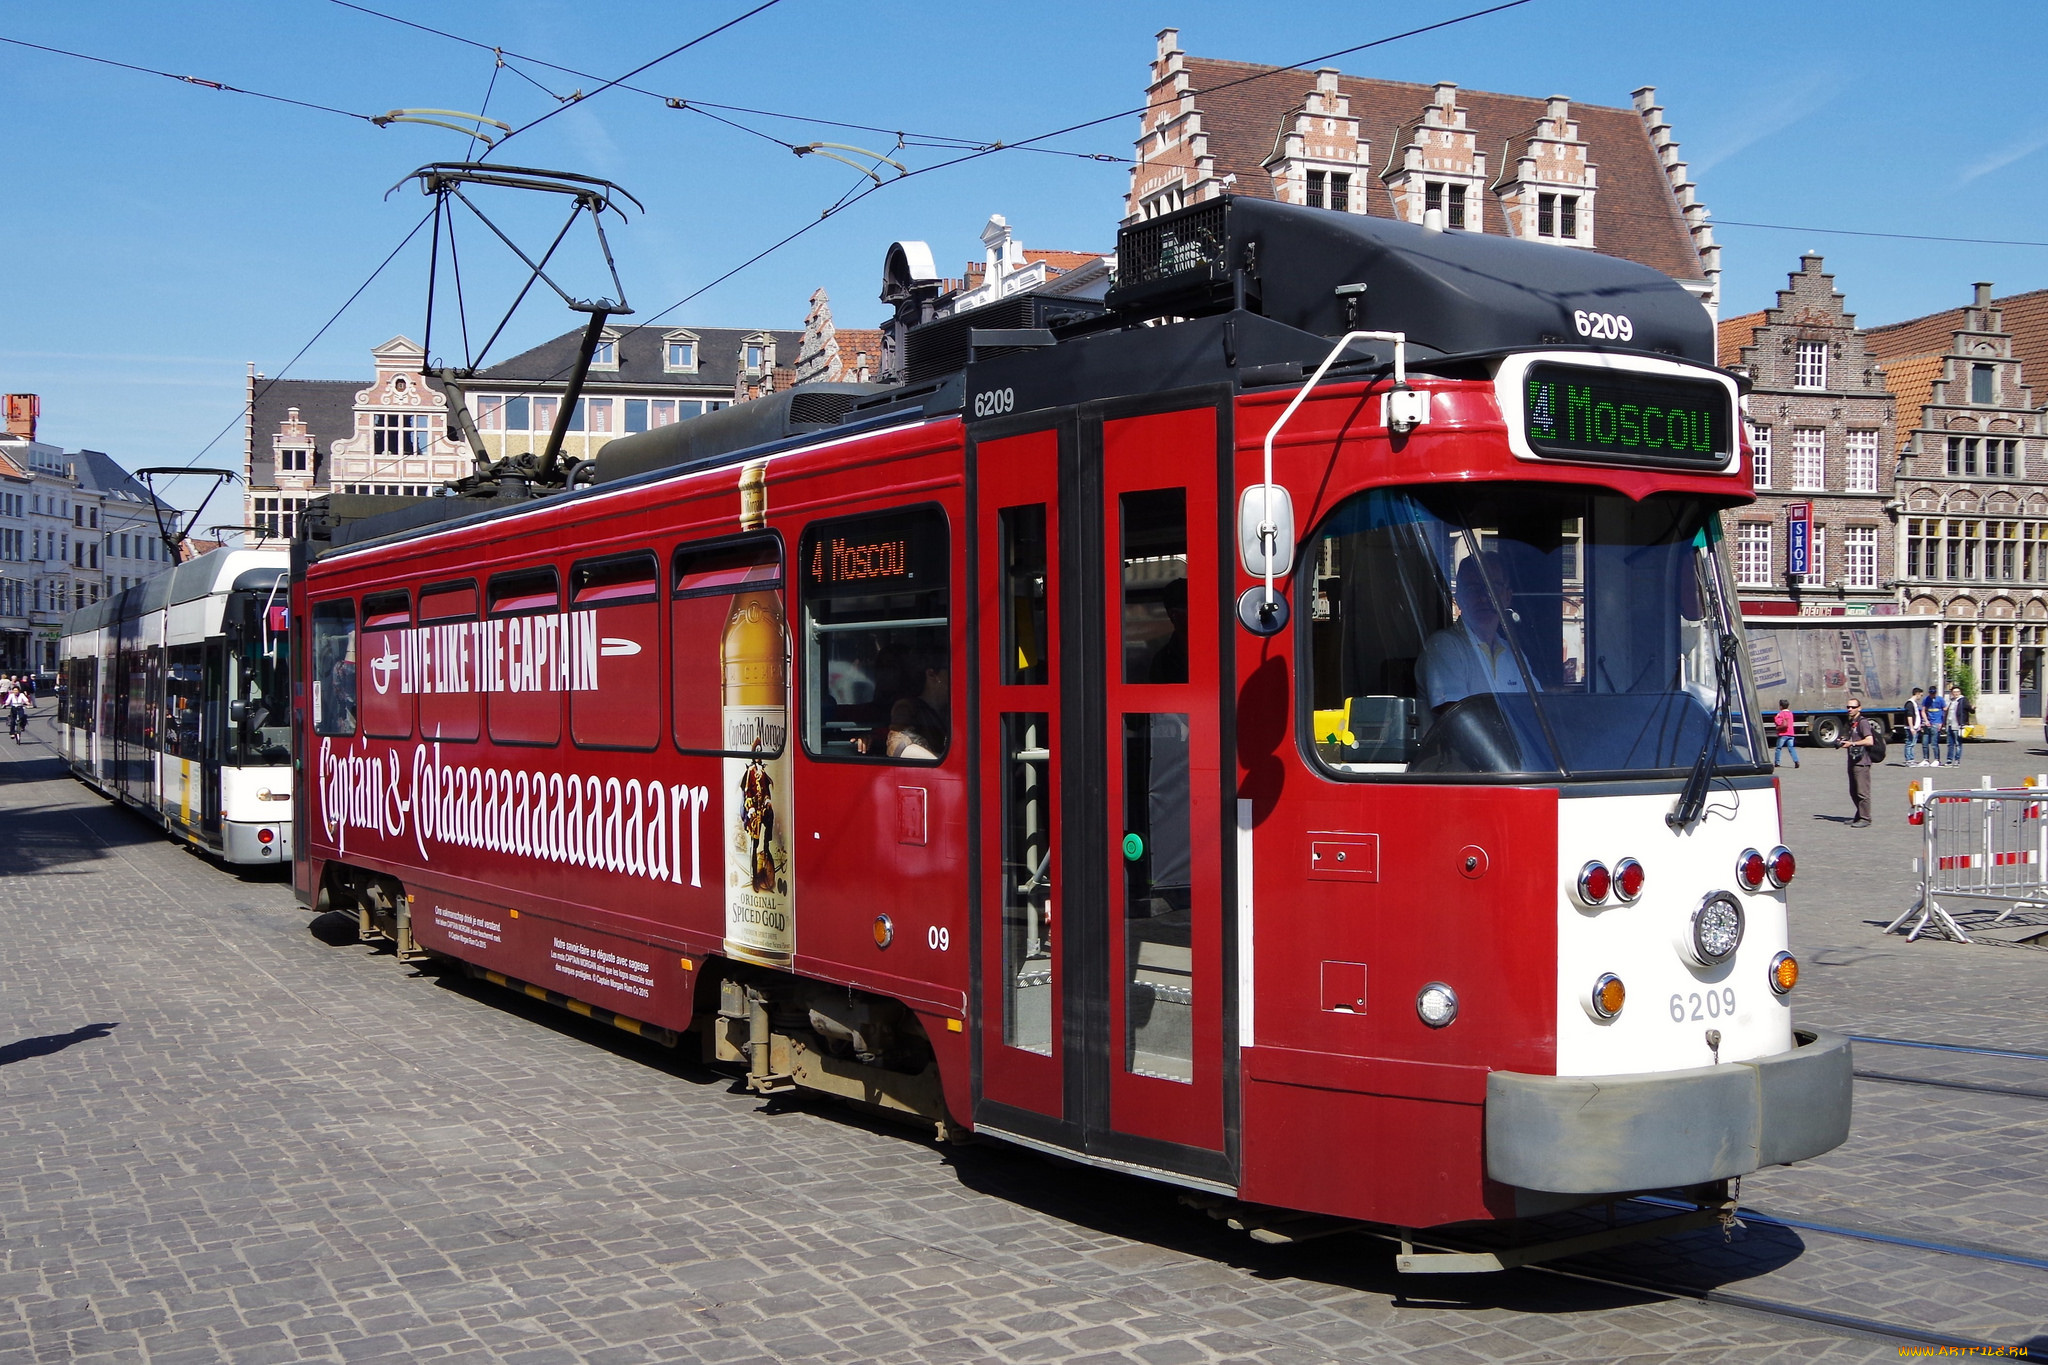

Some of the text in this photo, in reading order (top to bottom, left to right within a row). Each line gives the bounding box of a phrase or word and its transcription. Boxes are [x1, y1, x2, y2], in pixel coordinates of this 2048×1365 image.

[1574, 309, 1634, 342] 6209
[975, 387, 1014, 417] 6209
[1532, 383, 1554, 434] 4
[812, 541, 822, 582] 4
[1794, 523, 1804, 572] SHOP
[400, 610, 598, 693] LIVE LIKE THE CAPTAIN
[1839, 631, 1865, 698] Jupiler
[728, 716, 754, 751] Captain
[320, 735, 384, 858] Captain
[385, 747, 411, 836] &
[732, 902, 785, 932] SPICED GOLD
[741, 893, 776, 909] ORIGINAL
[553, 936, 649, 973] Notre savoir-faire se déguste avec sagesse
[928, 925, 950, 951] 09
[596, 974, 610, 986] Captain
[638, 987, 649, 998] 2015
[1669, 987, 1736, 1023] 6209
